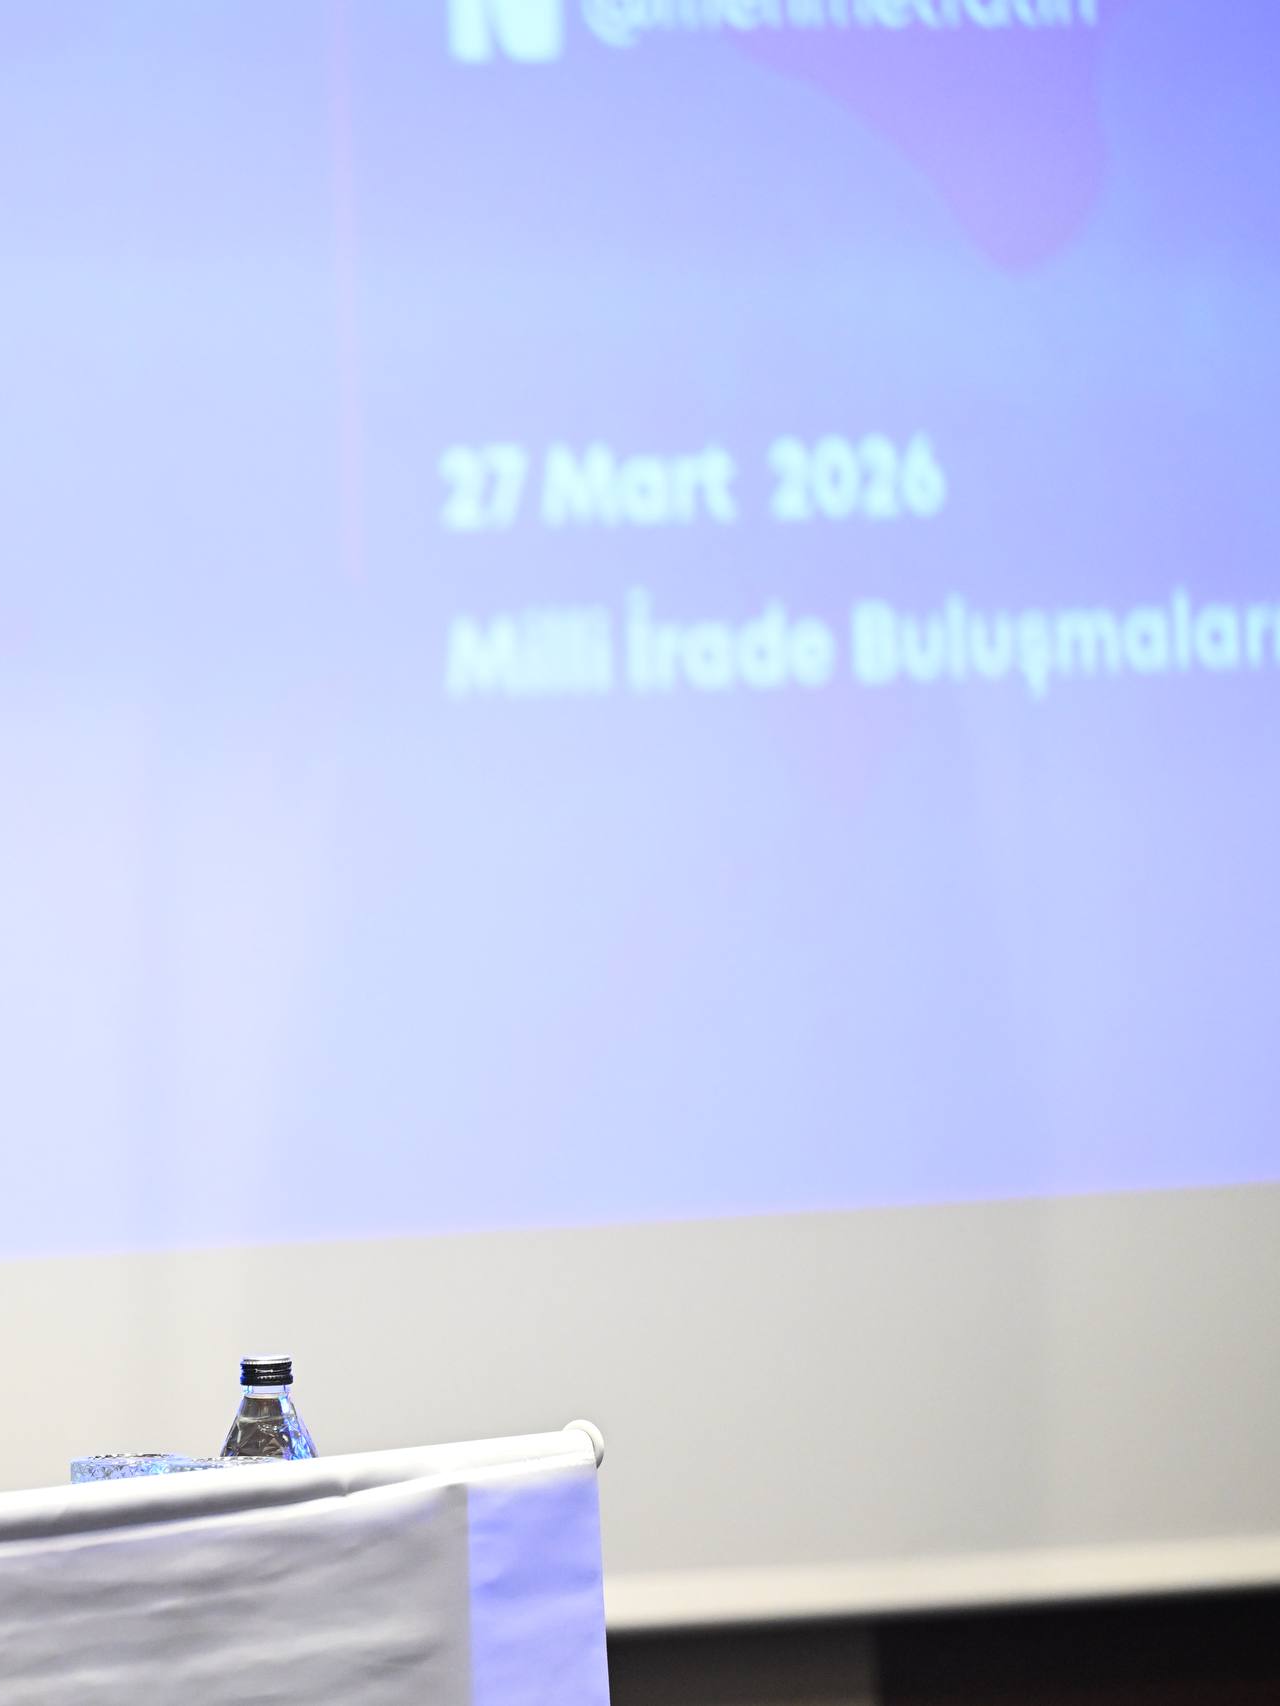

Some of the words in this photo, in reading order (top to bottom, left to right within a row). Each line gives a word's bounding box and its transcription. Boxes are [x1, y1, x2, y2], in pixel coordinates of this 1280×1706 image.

[440, 442, 524, 530] 27
[542, 441, 736, 528] Mart
[768, 432, 946, 520] 2026
[852, 588, 1280, 700] Buluşmalar
